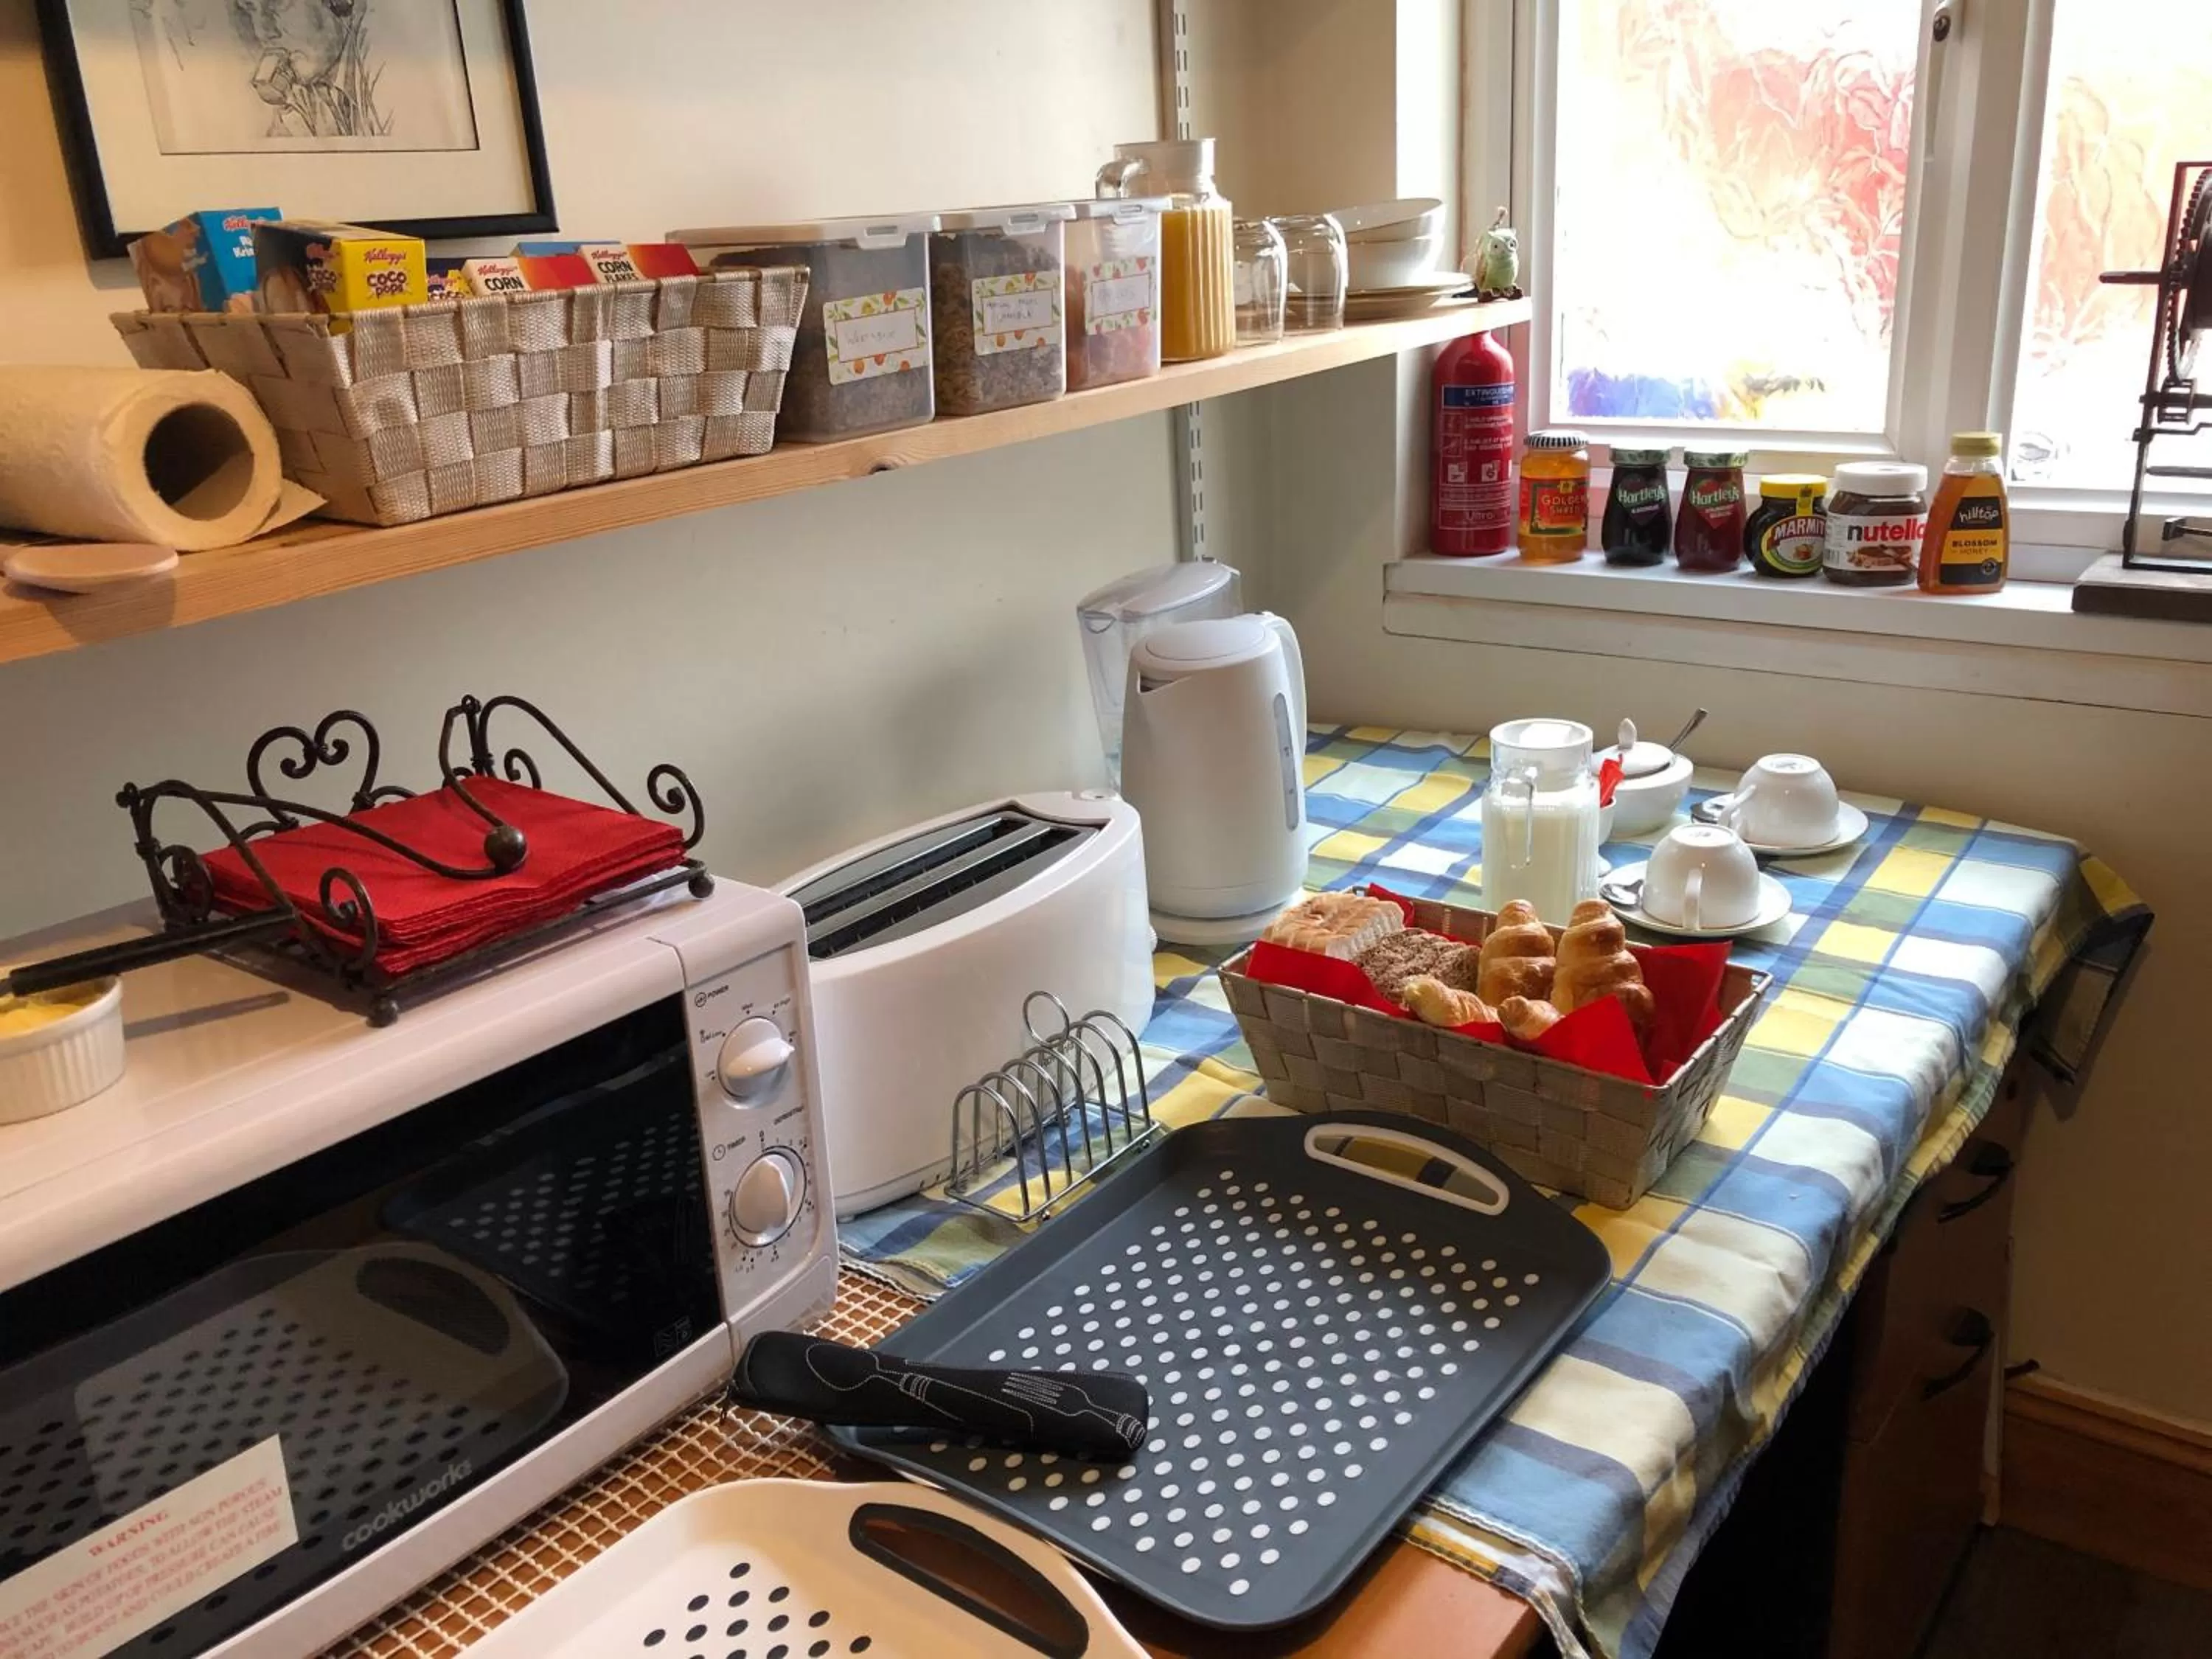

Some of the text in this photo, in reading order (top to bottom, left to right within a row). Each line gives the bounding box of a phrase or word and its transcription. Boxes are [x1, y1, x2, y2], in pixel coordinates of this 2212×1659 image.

[364, 248, 406, 264] Kellogg's
[597, 260, 633, 274] CORN
[484, 276, 524, 291] CORN
[1618, 484, 1666, 504] Hartley's
[1691, 486, 1740, 506] Hartley's
[1958, 506, 1999, 523] hilltop
[1774, 518, 1826, 540] MARMIT
[1847, 518, 1927, 543] nutella
[342, 1458, 473, 1551] cookworks
[88, 1509, 169, 1558] WARNING
